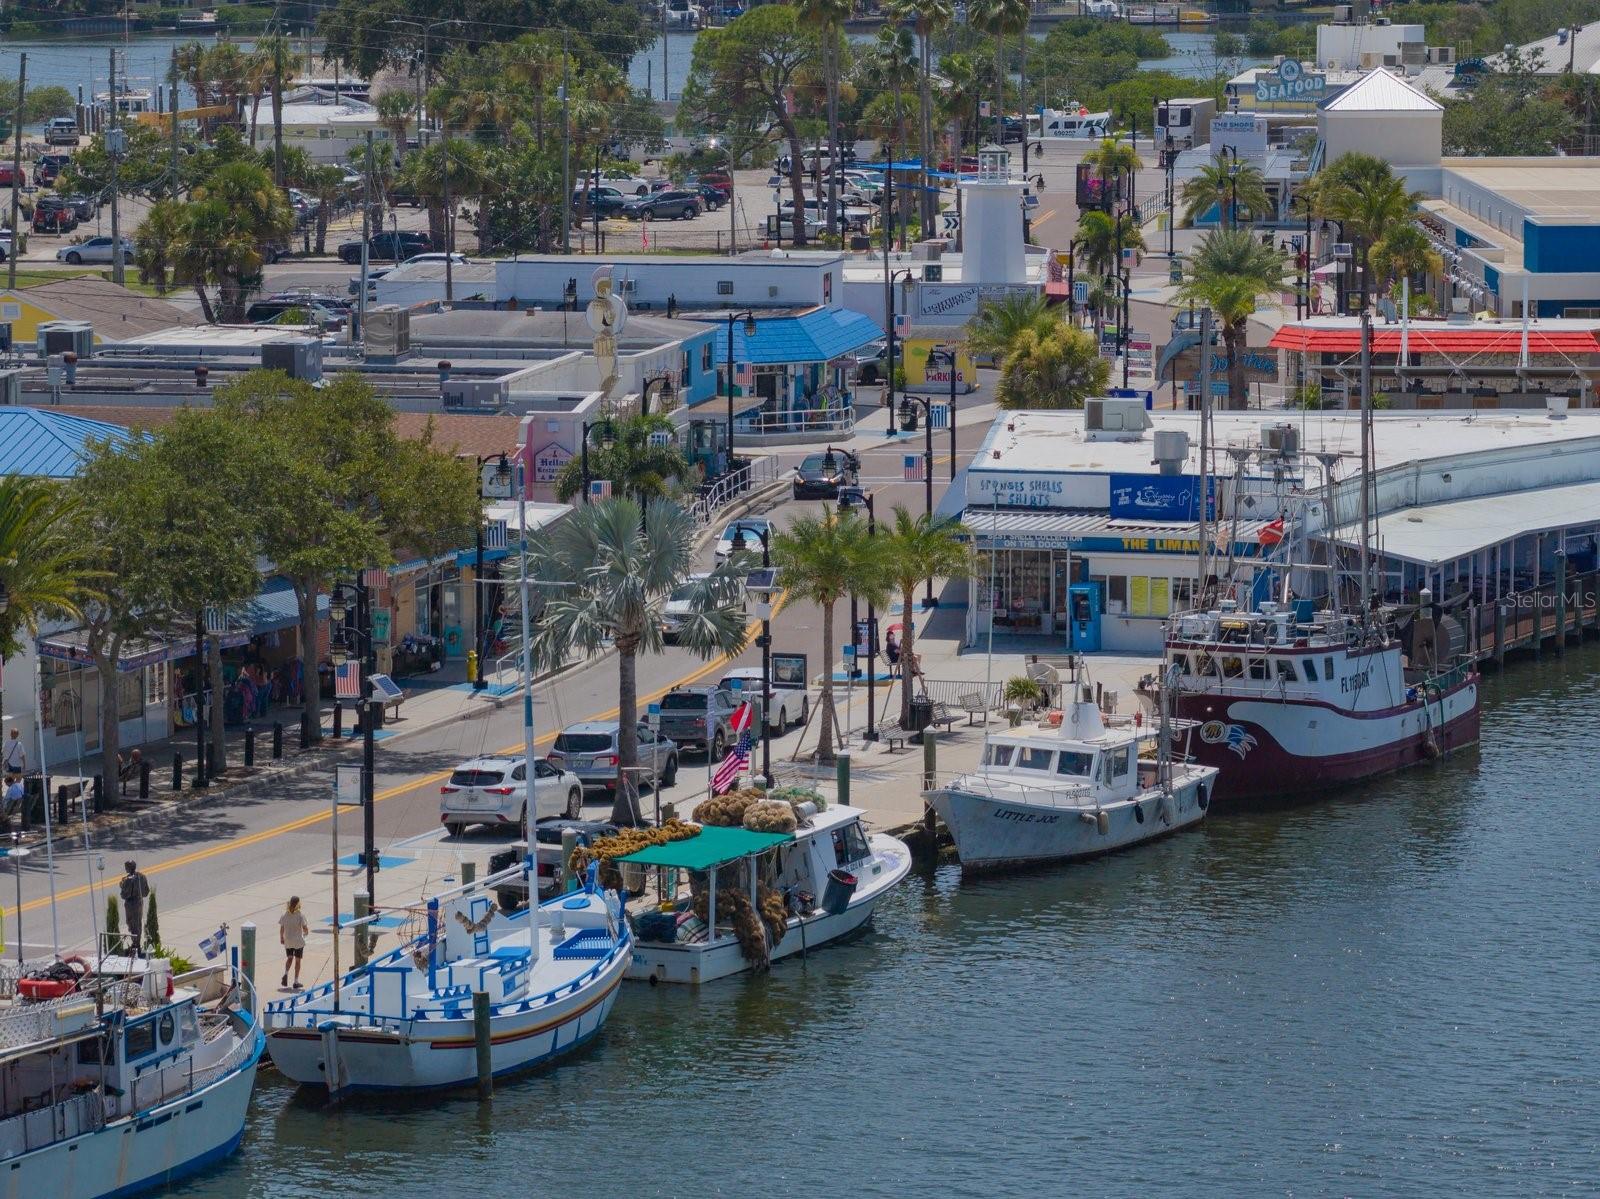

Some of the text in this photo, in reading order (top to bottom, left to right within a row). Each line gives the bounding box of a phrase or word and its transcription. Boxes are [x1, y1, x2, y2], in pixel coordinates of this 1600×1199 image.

[1256, 77, 1323, 101] SEAFOOD
[923, 287, 979, 314] LIGHTHOUSE
[1029, 481, 1063, 494] SHELLS
[1038, 541, 1068, 549] DOCKS
[1122, 538, 1149, 550] THE
[994, 808, 1060, 824] LITTLE JOE
